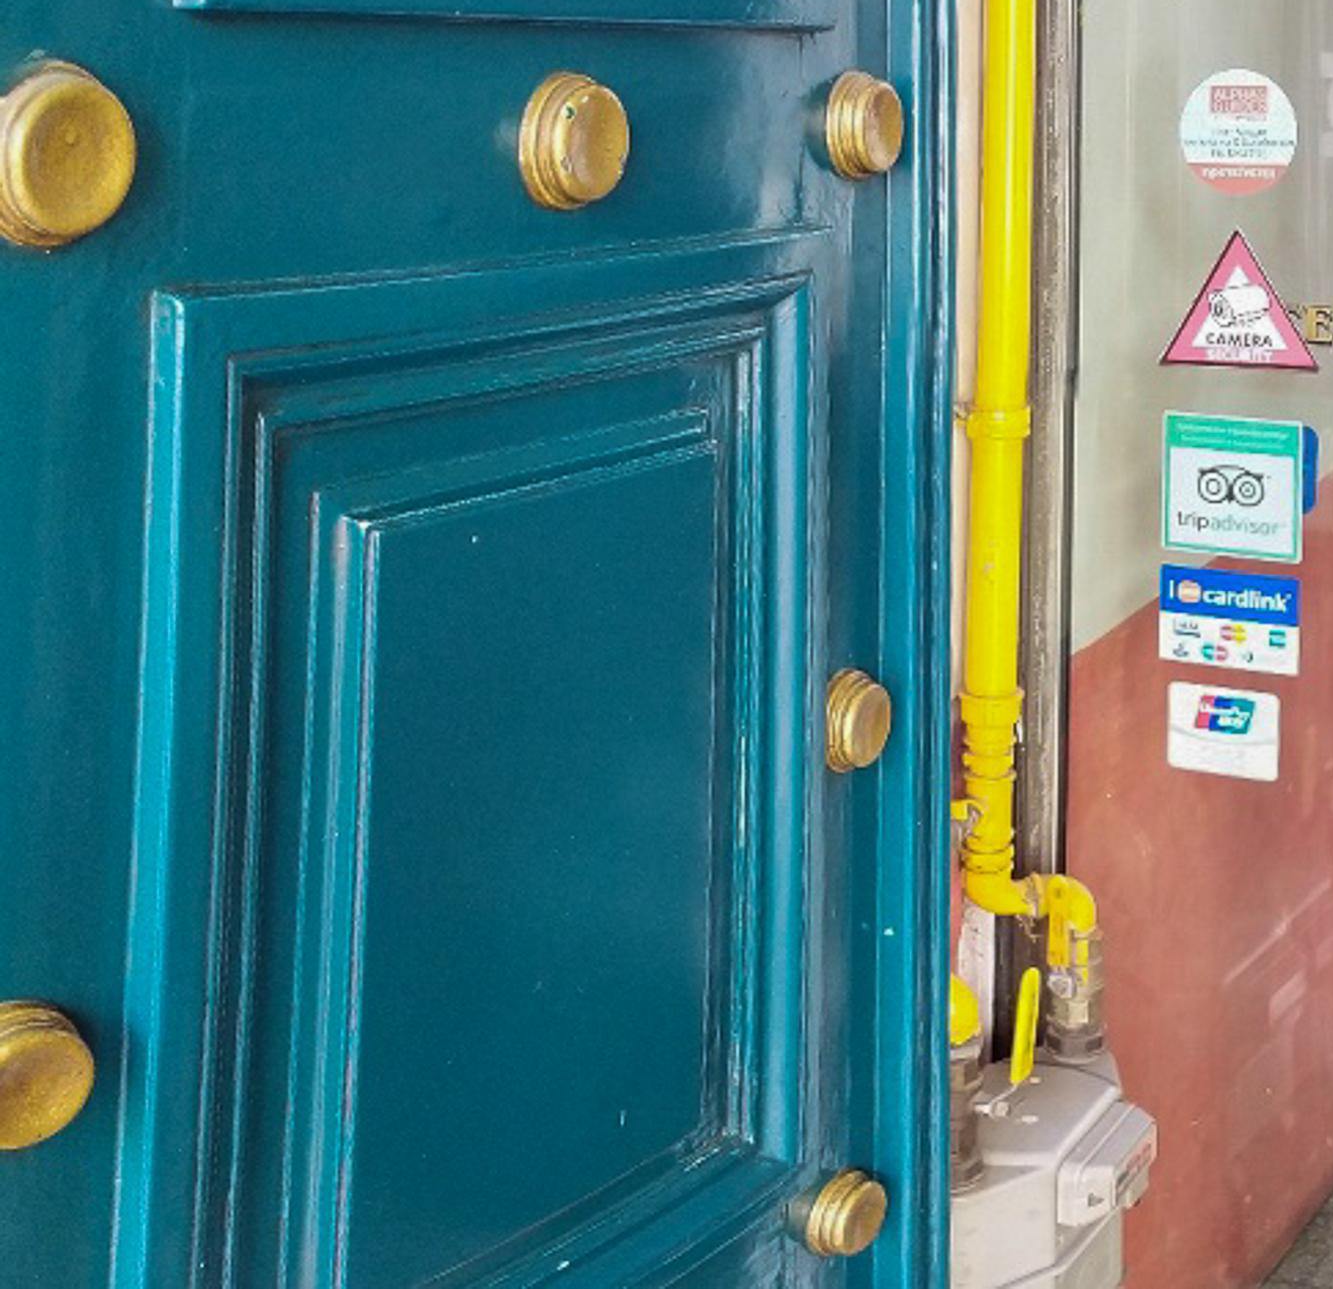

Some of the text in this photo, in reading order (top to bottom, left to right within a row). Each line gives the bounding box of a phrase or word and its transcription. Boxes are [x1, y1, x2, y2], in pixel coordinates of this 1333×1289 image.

[1205, 332, 1273, 348] CAMERA
[1177, 511, 1279, 536] tripadvisor
[1202, 588, 1288, 612] cardlink
